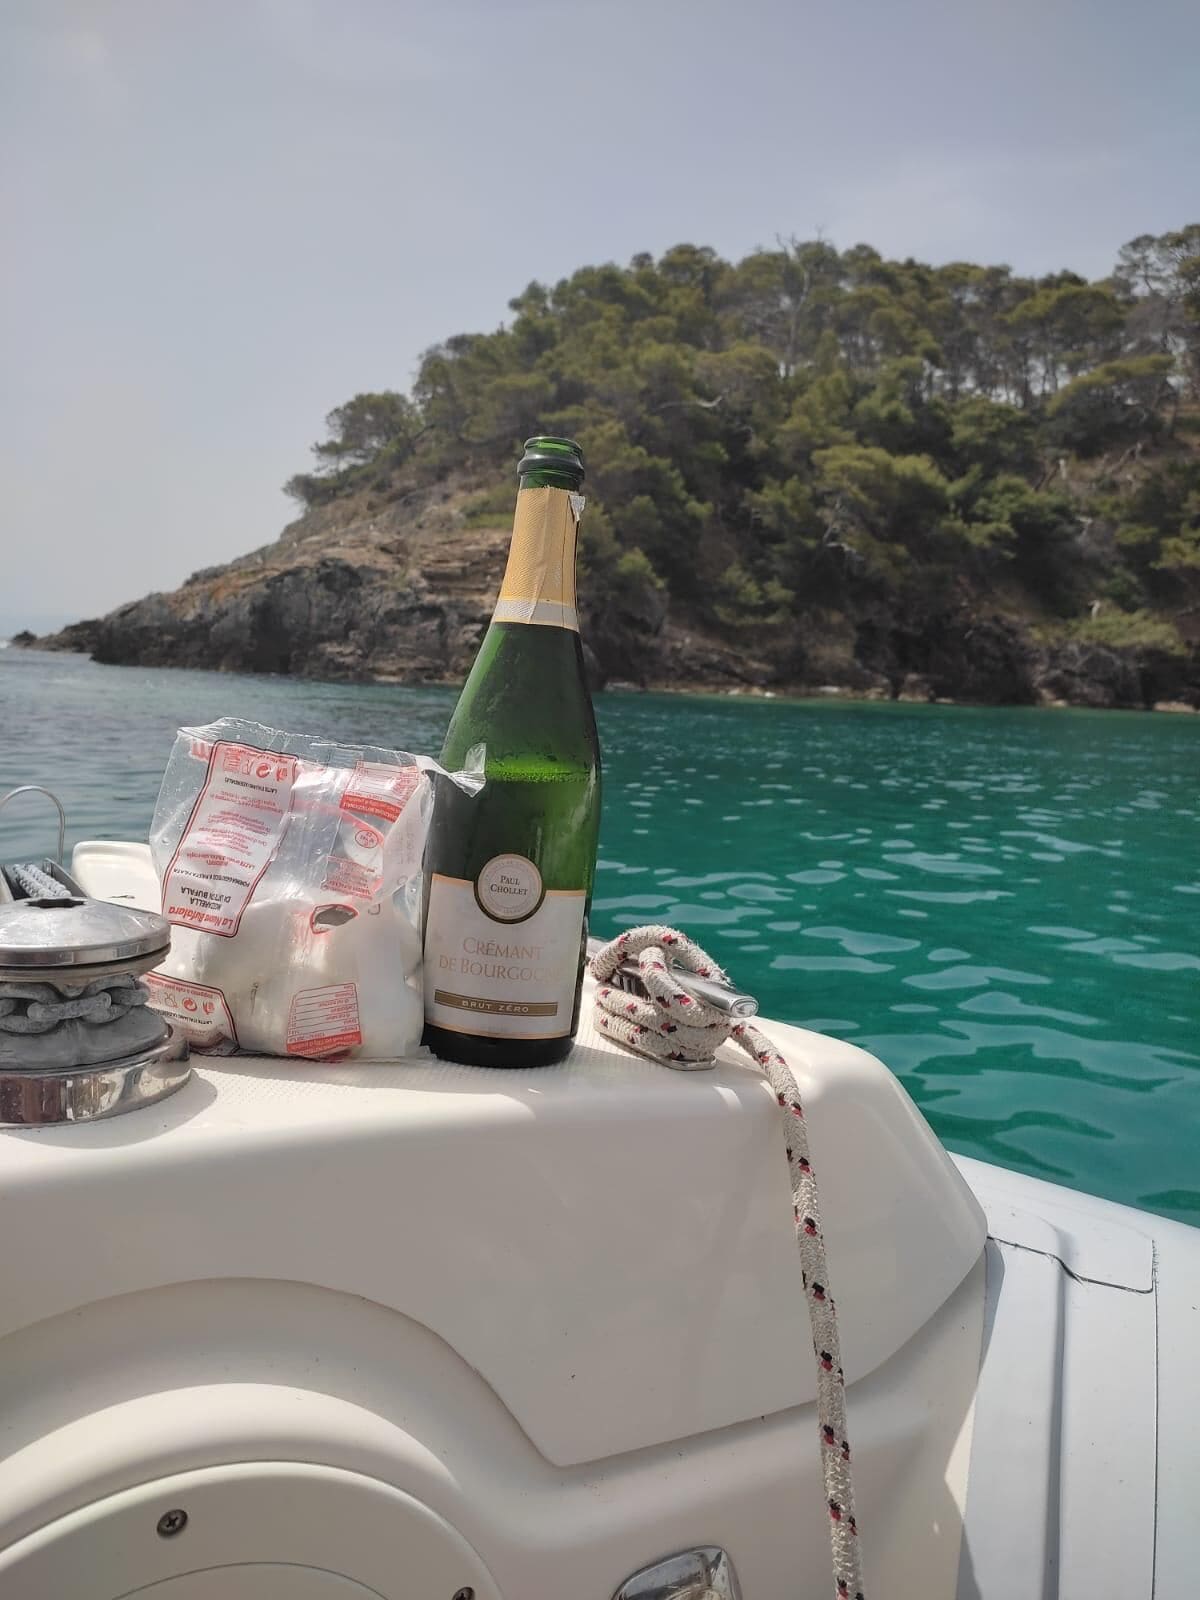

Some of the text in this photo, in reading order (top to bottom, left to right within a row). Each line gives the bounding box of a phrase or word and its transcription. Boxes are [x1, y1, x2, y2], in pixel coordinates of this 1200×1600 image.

[501, 875, 520, 885] PAUL
[181, 887, 209, 900] BUFALA
[490, 884, 528, 896] CHOLLET
[168, 906, 204, 923] Bufalara
[222, 916, 234, 929] La
[463, 937, 544, 960] CRÉMANT
[439, 955, 456, 971] DE
[462, 1000, 530, 1013] BRUT ZÉRO
